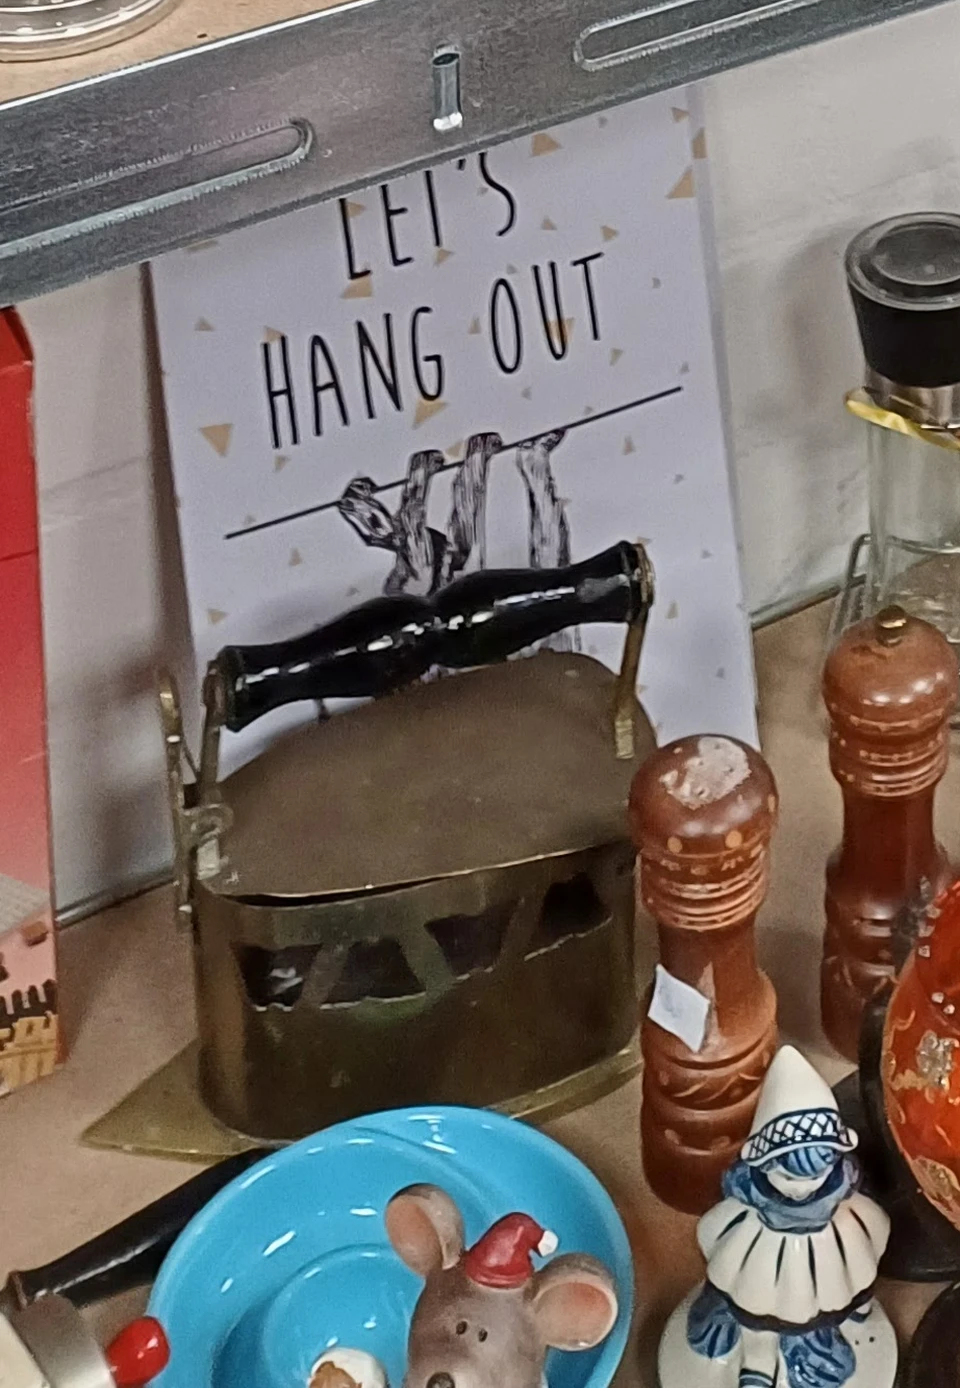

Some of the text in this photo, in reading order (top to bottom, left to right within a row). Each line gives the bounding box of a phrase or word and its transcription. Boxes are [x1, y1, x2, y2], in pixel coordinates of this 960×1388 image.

[337, 151, 518, 281] LET'S
[261, 251, 605, 450] HANG OUT
